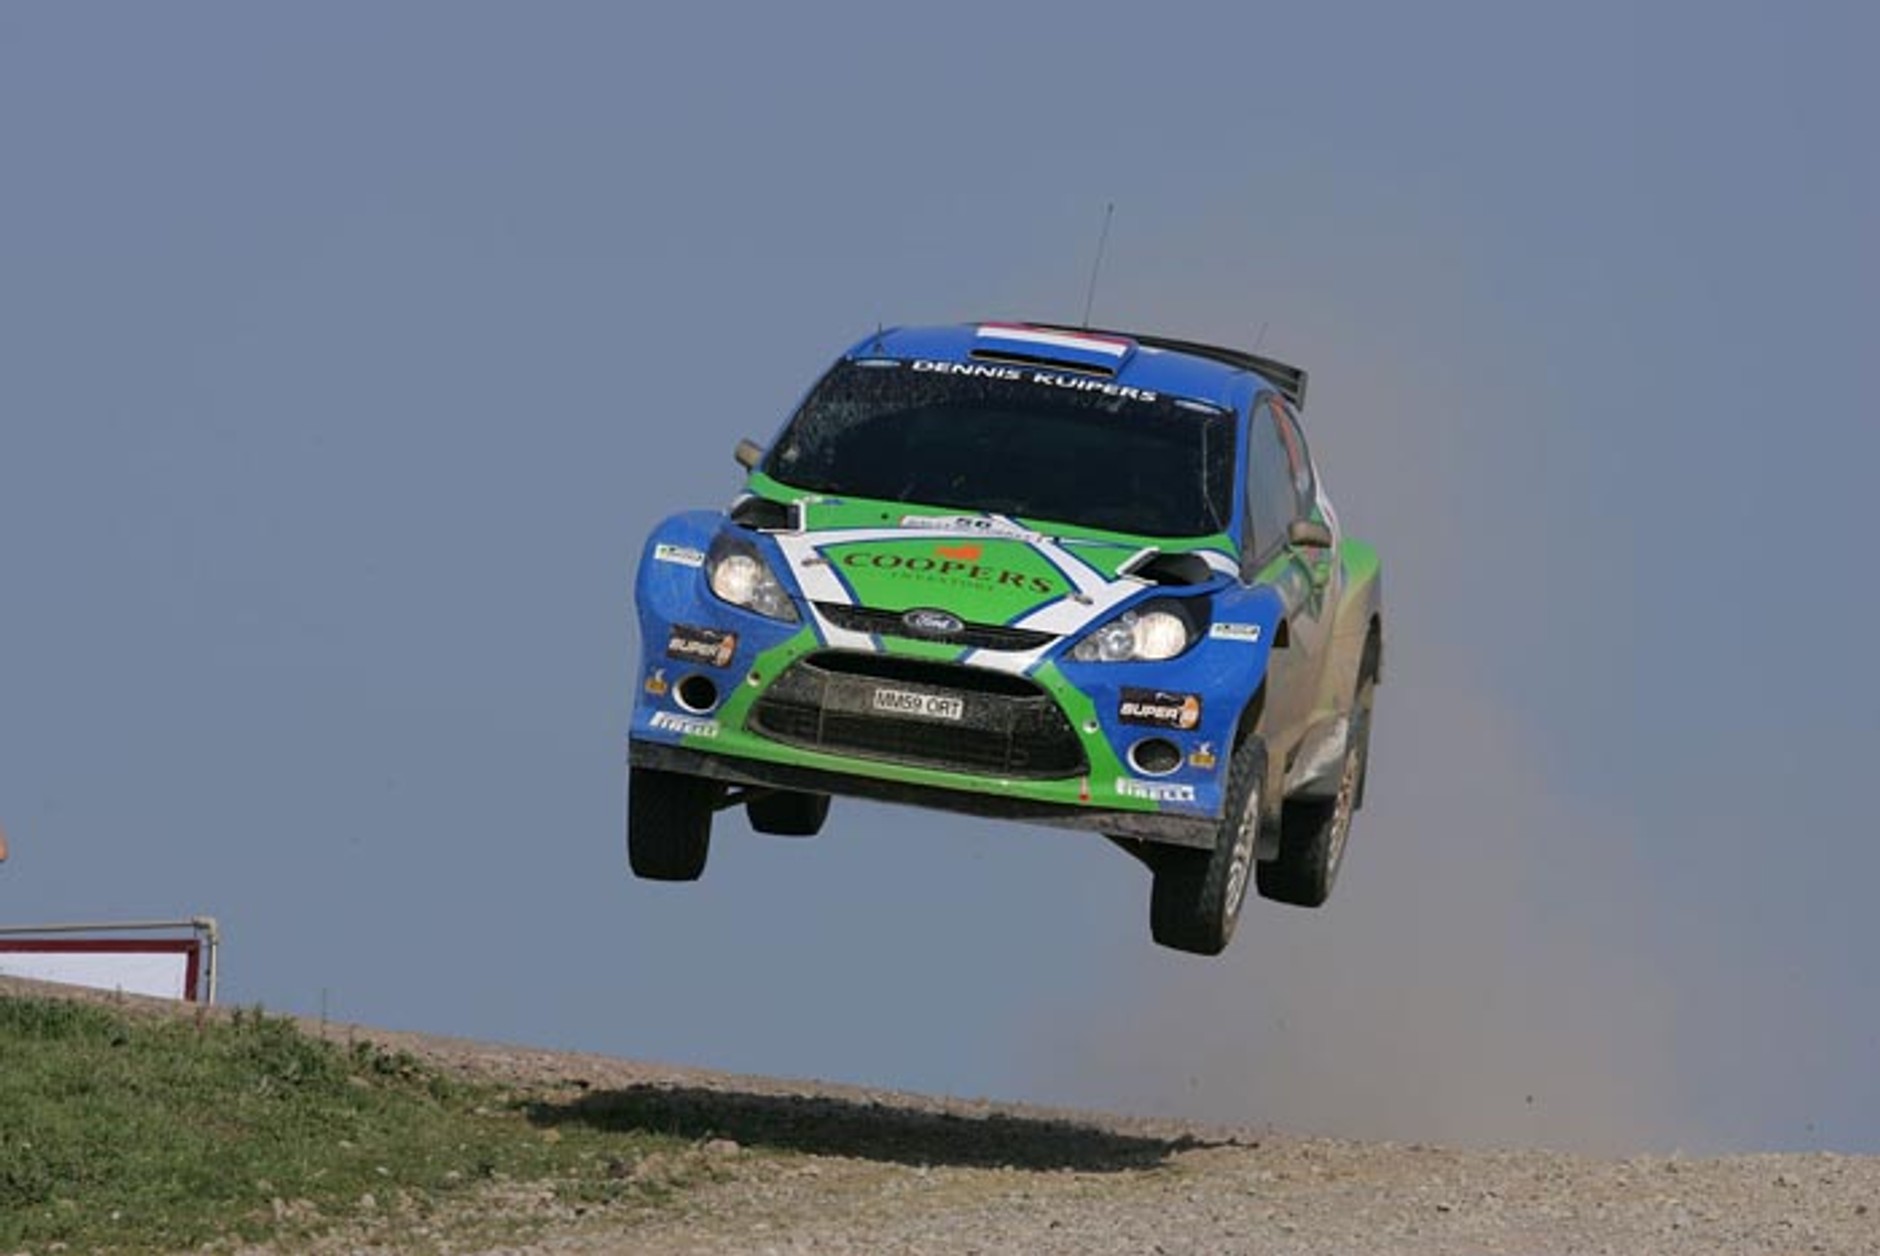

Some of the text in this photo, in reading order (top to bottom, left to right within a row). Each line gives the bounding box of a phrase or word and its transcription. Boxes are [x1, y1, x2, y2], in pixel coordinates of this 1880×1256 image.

[911, 359, 1157, 402] DENNIS KUIPERS
[956, 516, 991, 529] 56
[843, 552, 1054, 595] COOPERS
[914, 611, 951, 630] Ford
[1120, 702, 1178, 720] SUPER
